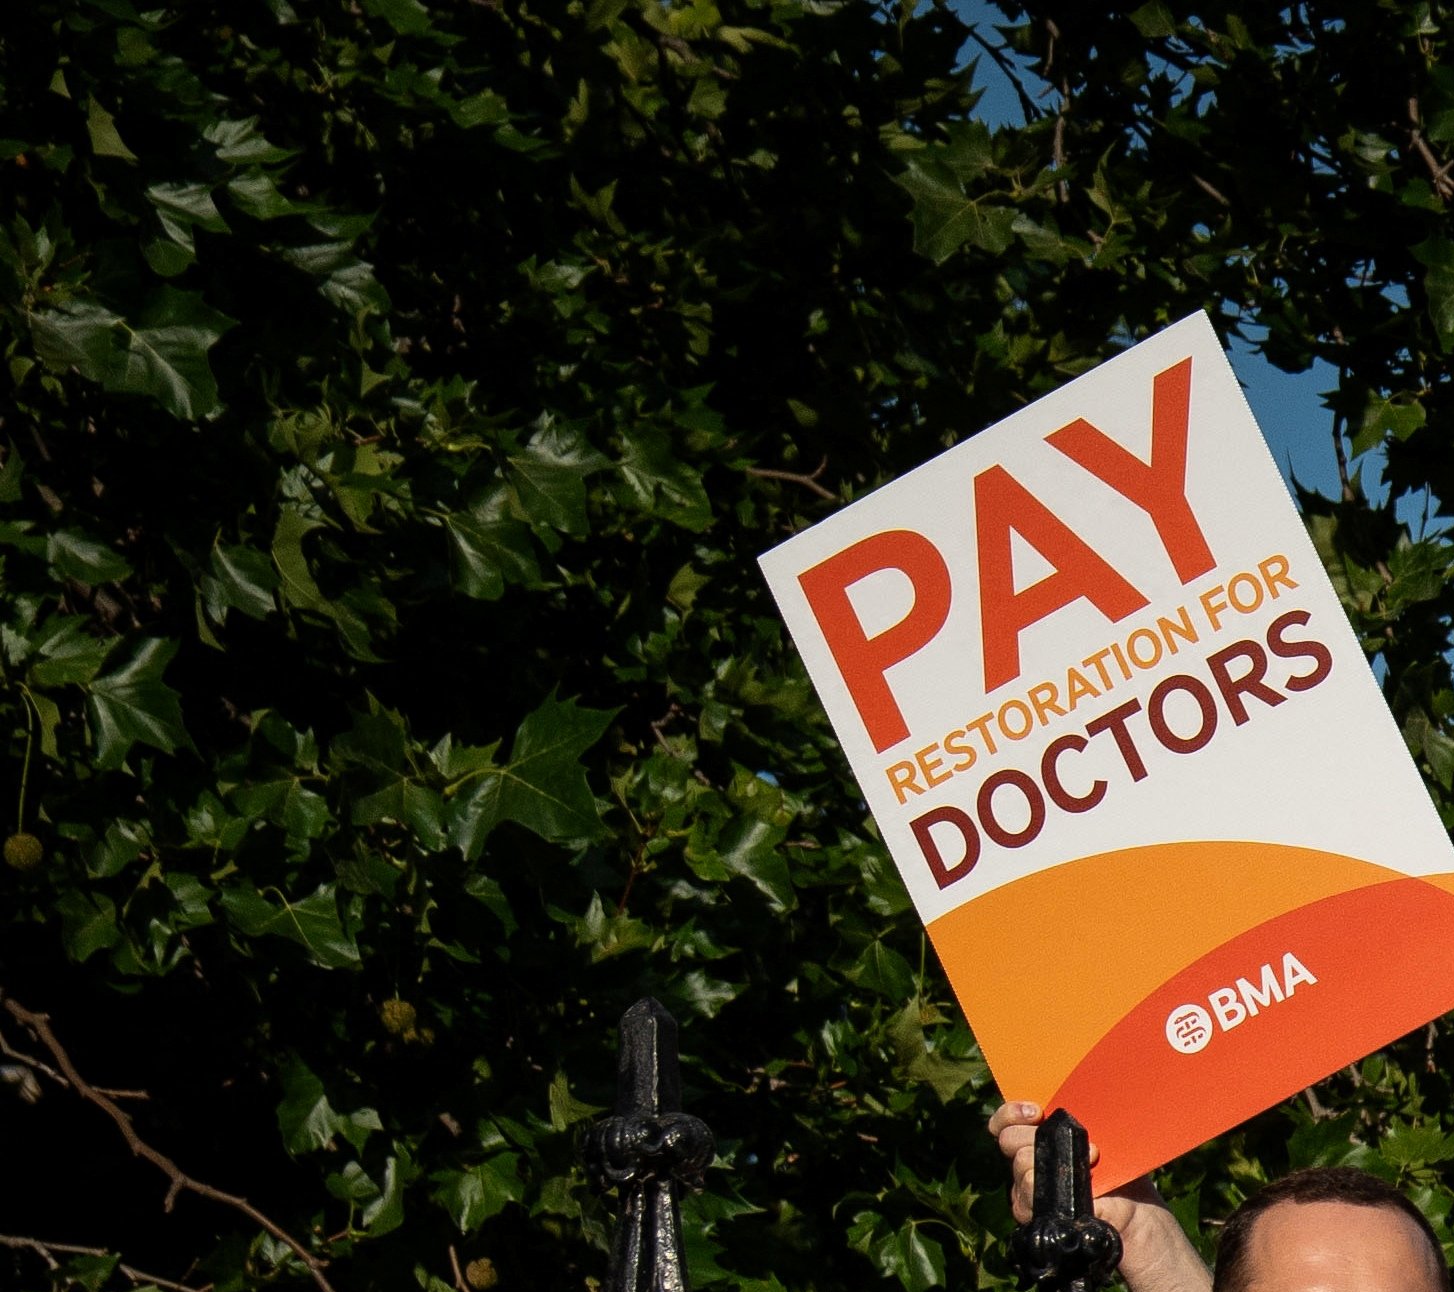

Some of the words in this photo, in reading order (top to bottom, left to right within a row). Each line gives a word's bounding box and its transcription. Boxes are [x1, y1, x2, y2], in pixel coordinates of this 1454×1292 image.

[797, 356, 1216, 755] PAY
[886, 606, 1199, 805] RESTORATION
[1201, 554, 1299, 634] FOR
[909, 611, 1333, 890] DOCTORS
[1209, 952, 1317, 1032] BMA
